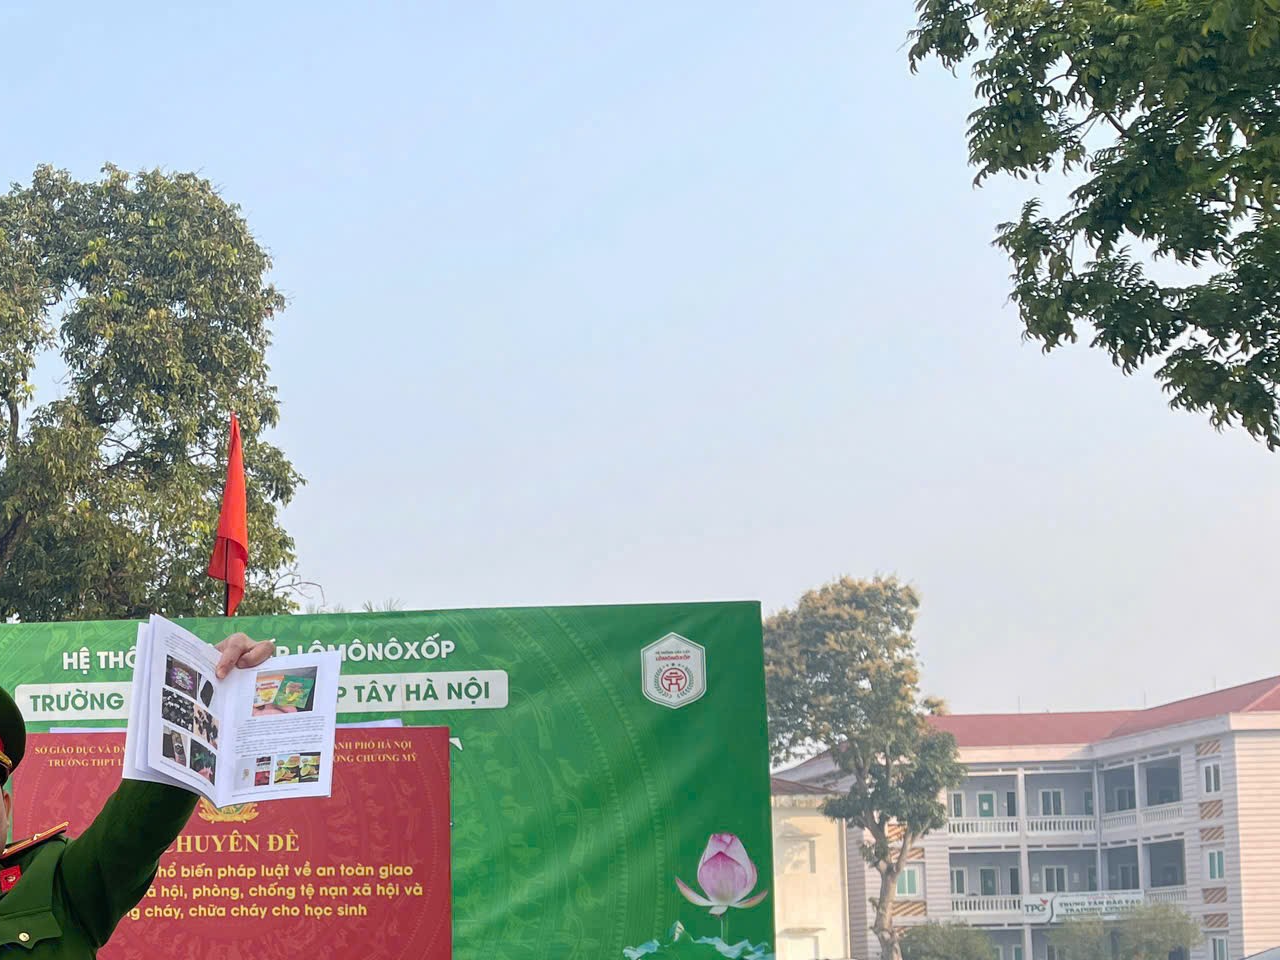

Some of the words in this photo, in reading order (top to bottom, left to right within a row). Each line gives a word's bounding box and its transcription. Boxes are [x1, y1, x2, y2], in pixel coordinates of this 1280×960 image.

[62, 646, 91, 675] HỆ
[29, 688, 125, 713] TRƯỜNG
[353, 680, 397, 703] TÂY
[405, 678, 439, 701] HÀ
[447, 676, 490, 705] NỘI
[76, 745, 96, 755] DỤC
[90, 758, 115, 767] THPT
[165, 829, 260, 853] HUYÊN
[267, 828, 300, 852] ĐỀ
[181, 862, 213, 878] biến
[218, 863, 257, 879] pháp
[261, 863, 290, 880] luật
[294, 860, 312, 877] về
[316, 865, 336, 877] an
[340, 862, 375, 877] toàn
[378, 863, 414, 879] giao
[161, 884, 188, 901] hội,
[192, 883, 244, 901] phòng,
[249, 881, 296, 900] chống
[300, 883, 315, 900] tệ
[319, 885, 348, 900] nạn
[352, 883, 372, 896] xã
[376, 883, 400, 900] hội
[404, 882, 423, 896] và
[144, 903, 184, 920] cháy,
[189, 903, 226, 917] chữa
[230, 903, 268, 920] cháy
[272, 904, 300, 917] cho
[304, 903, 333, 920] học
[337, 903, 368, 917] sinh
[1024, 904, 1046, 913] TPG
